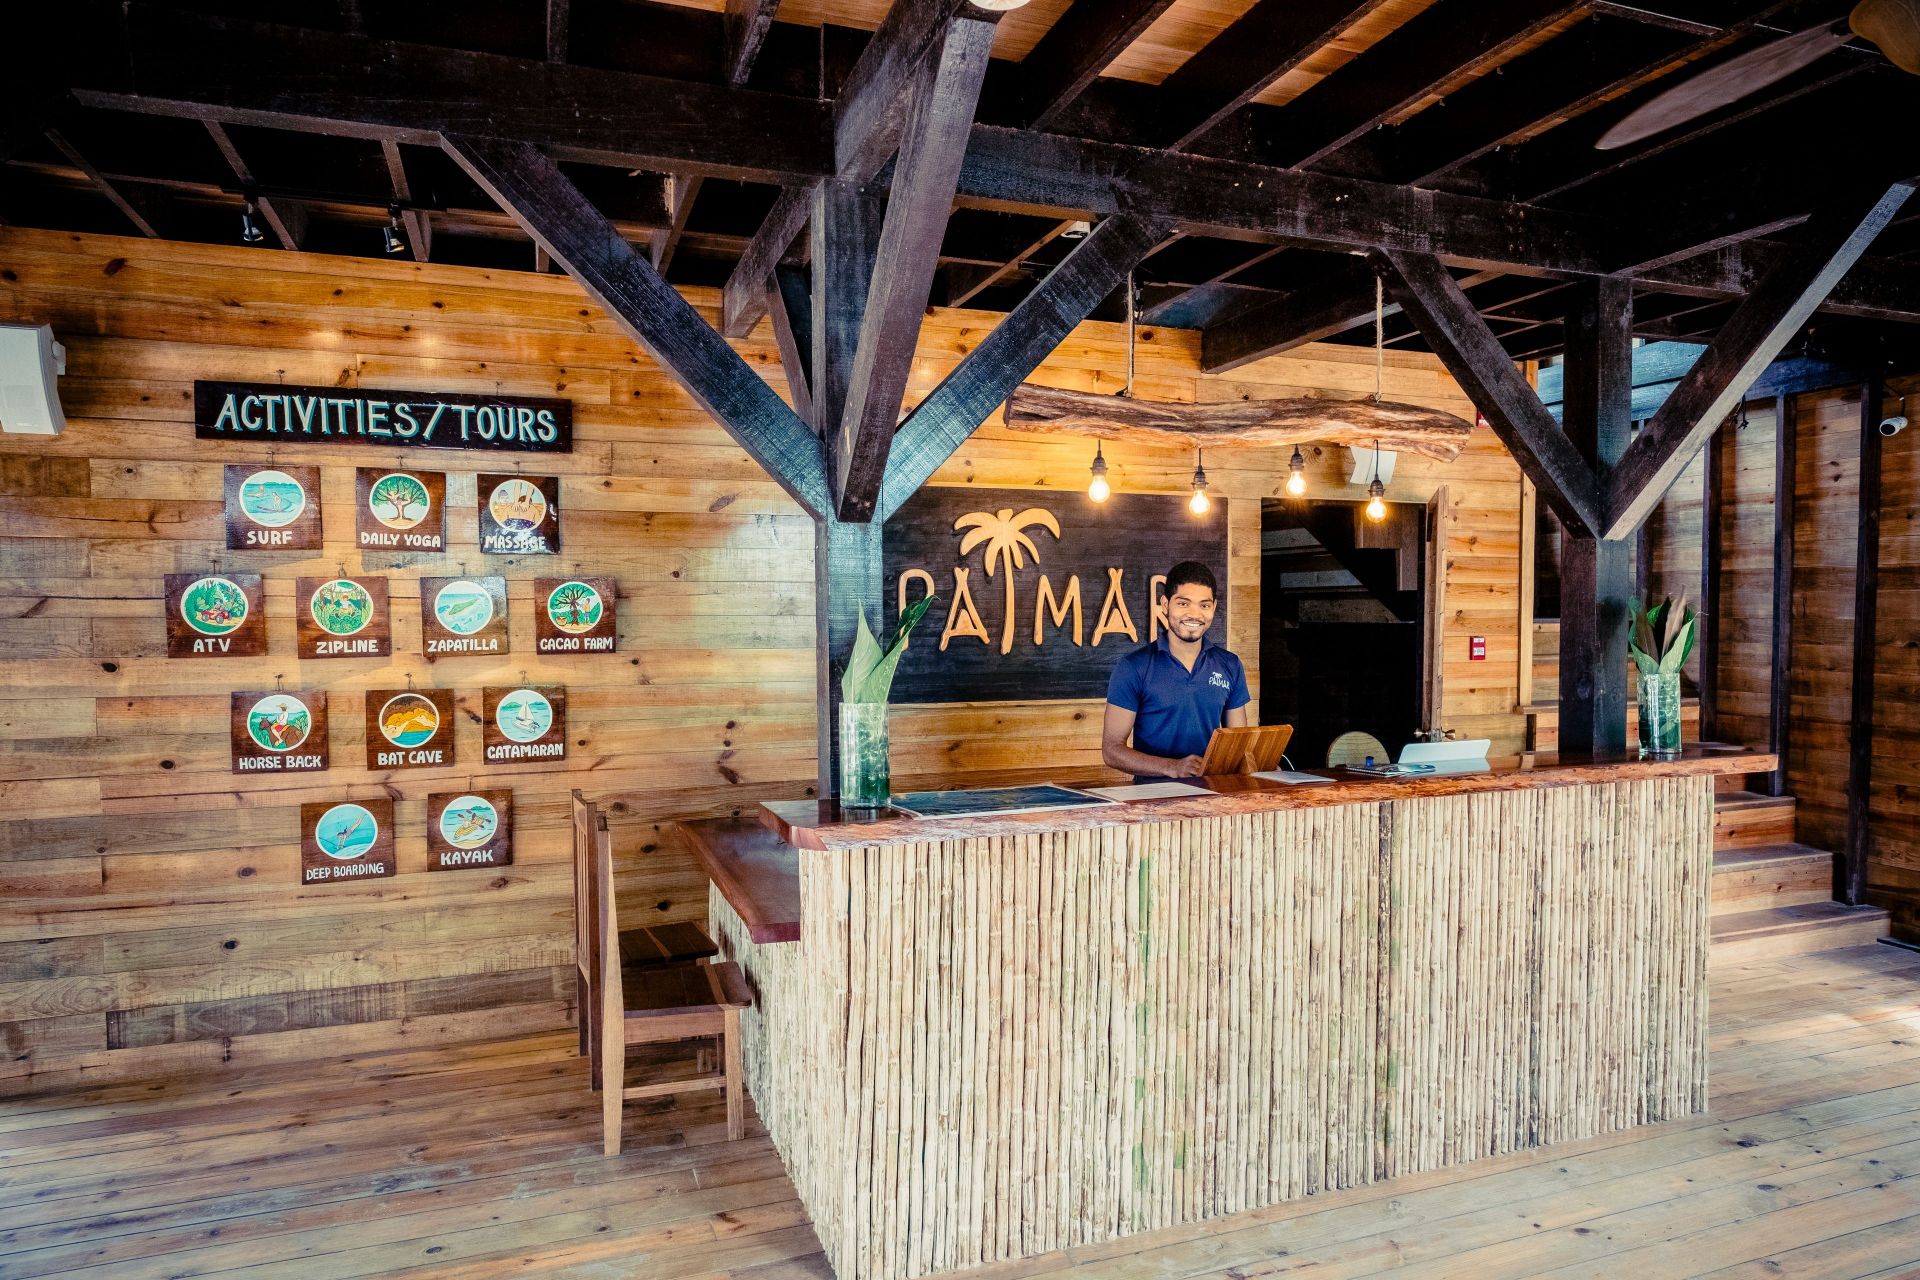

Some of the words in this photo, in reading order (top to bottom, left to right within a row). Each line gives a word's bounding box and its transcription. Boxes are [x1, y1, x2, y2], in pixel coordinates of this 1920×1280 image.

[246, 530, 292, 545] SURF
[360, 532, 400, 546] DAILY
[404, 534, 441, 548] YOGA
[484, 535, 546, 550] MASSAGE
[193, 638, 231, 653] ATV
[316, 639, 379, 654] ZIPLINE
[427, 637, 498, 652] ZAPATILLA
[540, 637, 580, 651] CACAO
[583, 636, 614, 650] FARM
[377, 751, 406, 766] BAT
[409, 750, 443, 764] CAVE
[487, 743, 564, 759] CATAMARAN
[239, 756, 281, 771] HORSE
[285, 754, 322, 769] BACK
[440, 849, 494, 865] KAYAK
[306, 867, 331, 880] DEEP
[333, 862, 385, 878] BOARDING
